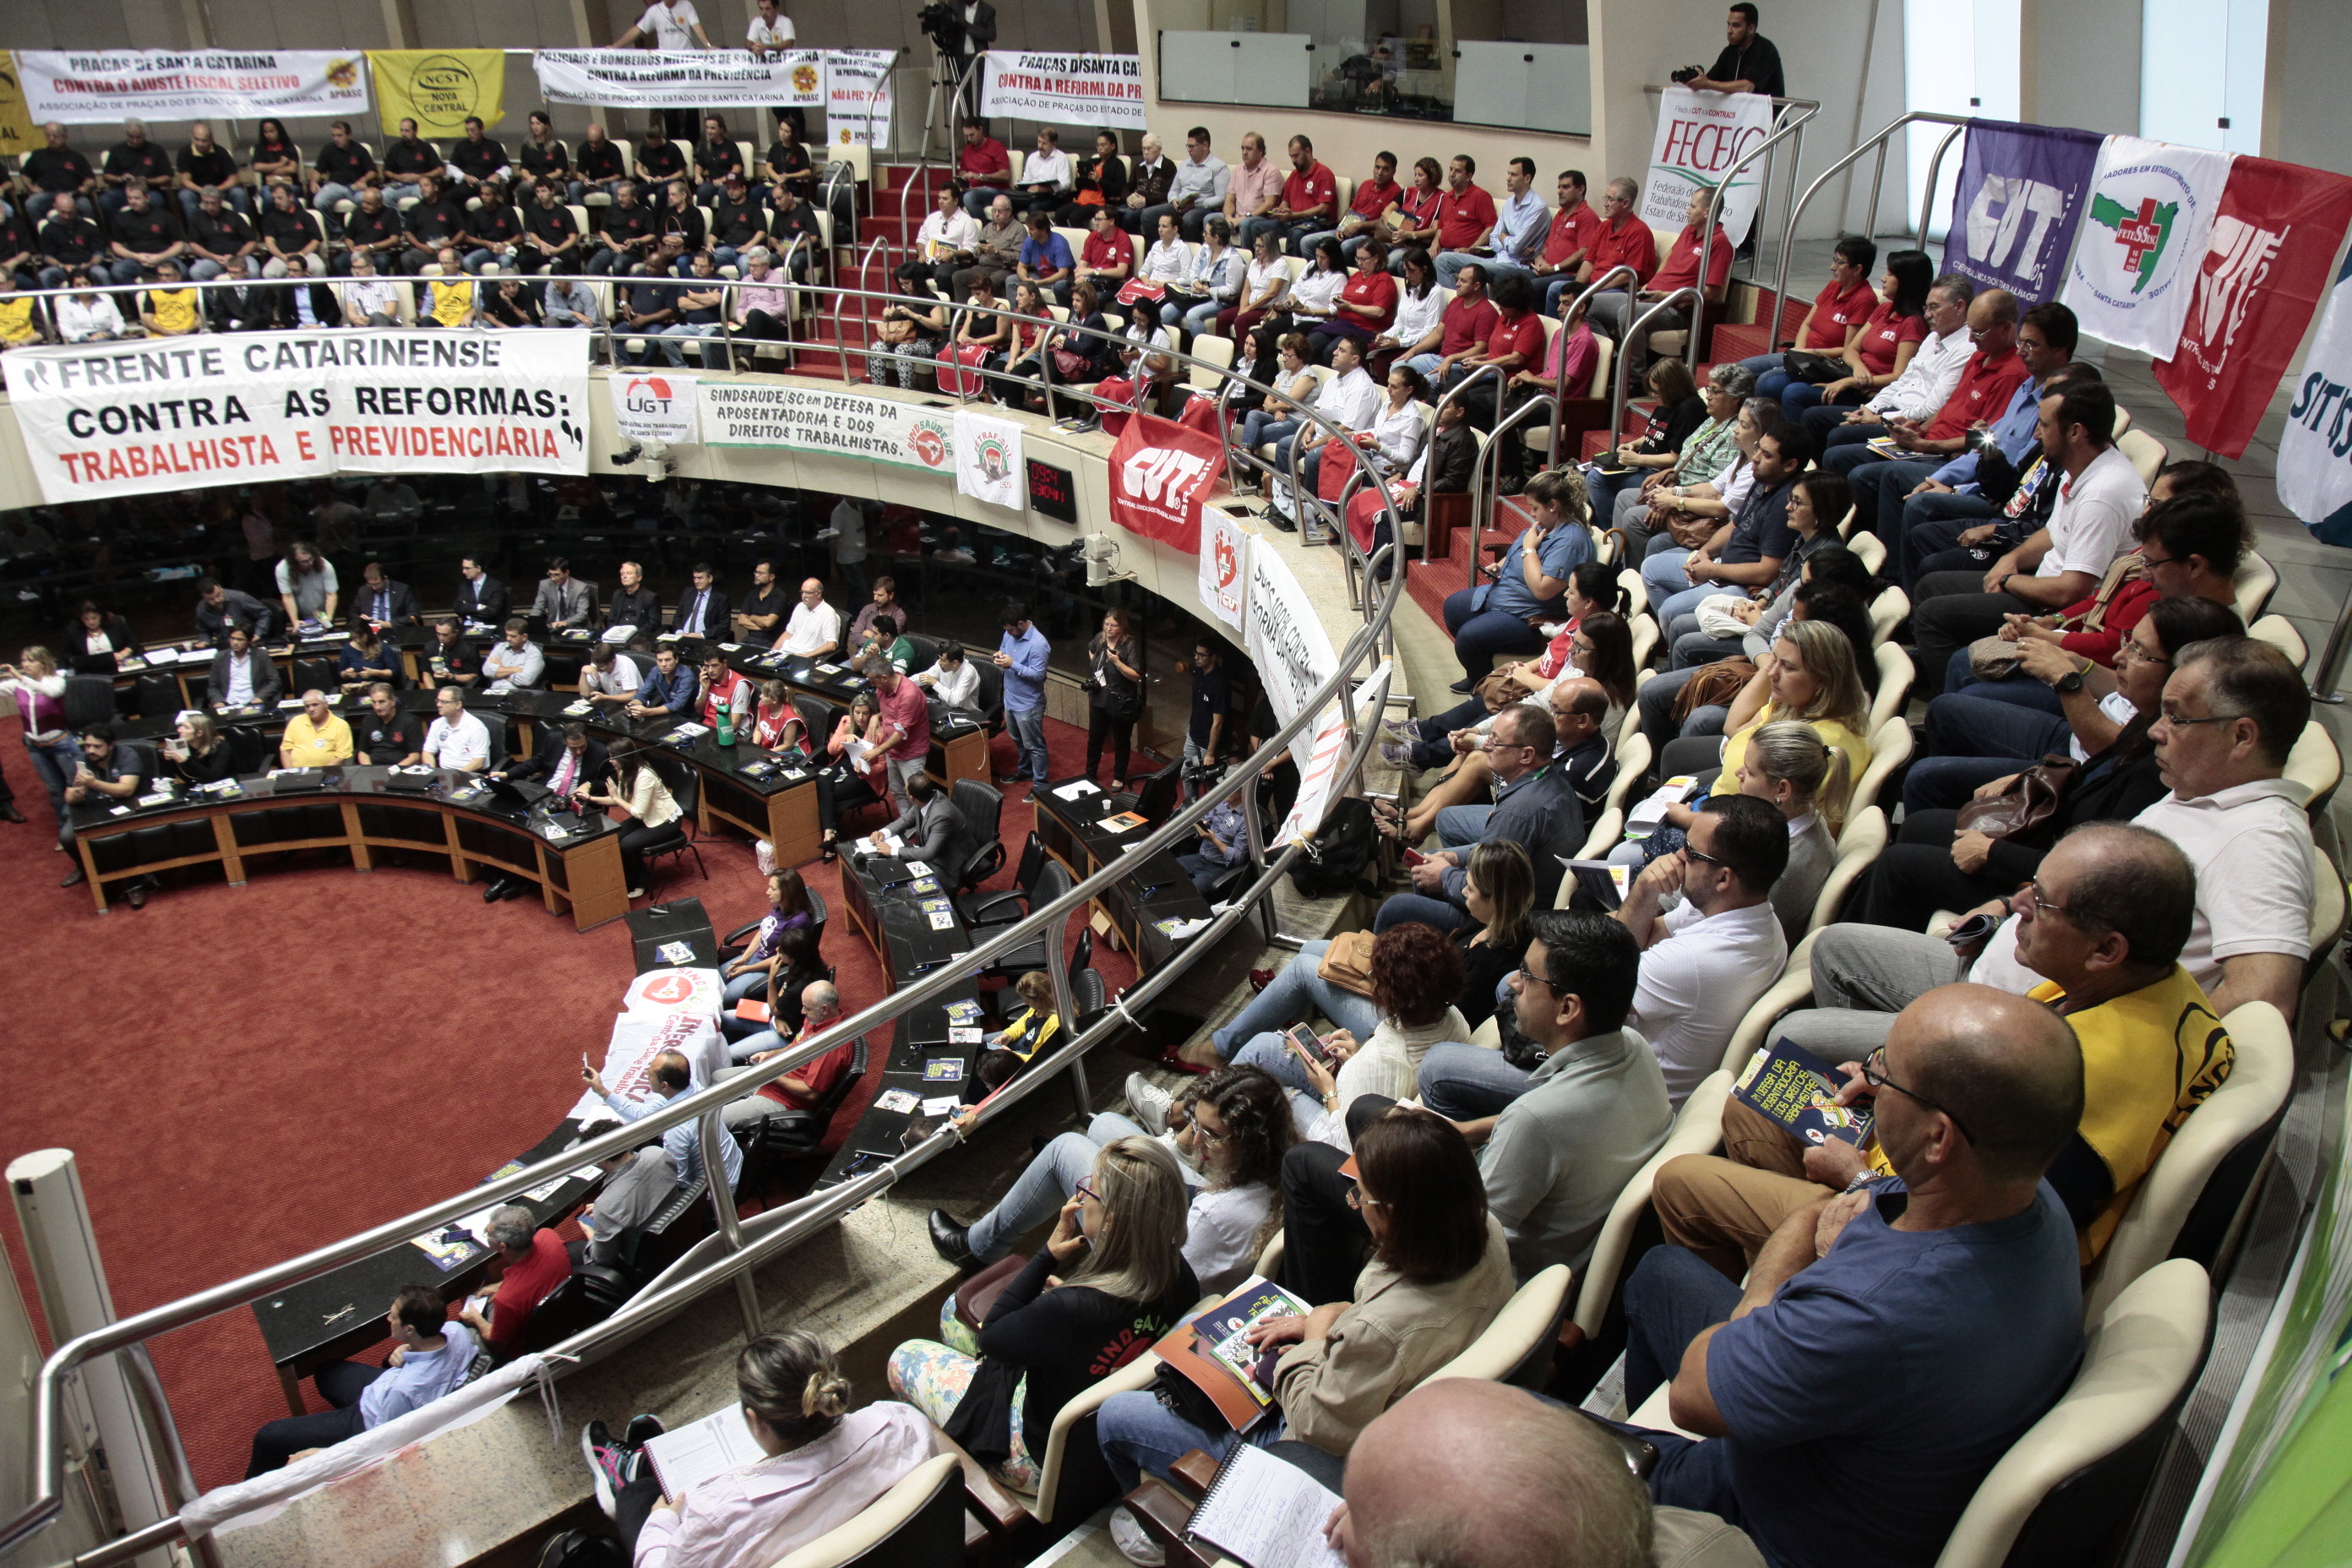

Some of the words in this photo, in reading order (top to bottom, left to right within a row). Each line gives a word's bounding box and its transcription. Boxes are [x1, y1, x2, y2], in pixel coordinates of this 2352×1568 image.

[206, 55, 277, 70] CATARINA
[601, 53, 661, 65] BOMBEIROS
[1019, 55, 1067, 73] PRAÇAS
[1083, 58, 1119, 75] SANTA
[427, 74, 460, 84] NCST
[587, 69, 628, 81] CONTRA
[689, 69, 702, 80] DA
[705, 68, 771, 80] PREVIDÊNCIA
[53, 79, 115, 94] CONTRA
[132, 75, 182, 91] AJUSTE
[186, 75, 234, 90] FISCAL
[239, 74, 301, 90] SELETIVO
[999, 74, 1041, 91] CONTRA
[1044, 78, 1053, 91] A
[1056, 79, 1105, 96] REFORMA
[1108, 82, 1124, 97] DA
[432, 92, 458, 101] NOVA
[598, 92, 610, 101] DE
[649, 94, 660, 102] DO
[663, 94, 695, 102] ESTADO
[699, 94, 709, 102] DE
[712, 93, 739, 102] SANTA
[742, 93, 784, 101] CATARINA
[792, 93, 819, 102] APRASC
[852, 90, 864, 101] PEC
[39, 100, 107, 112] ASSOCIAÇÃO
[110, 100, 122, 110] DE
[128, 98, 166, 110] PRAÇAS
[424, 103, 469, 113] CENTRAL
[1039, 101, 1050, 109] DE
[1053, 101, 1083, 112] PRAÇAS
[1086, 105, 1098, 113] DO
[1101, 106, 1129, 116] ESTADO
[1132, 107, 1141, 117] DE
[1709, 108, 1736, 119] CONTRACS
[854, 131, 876, 141] APRAC
[1662, 119, 1767, 174] FECESC
[1652, 180, 1685, 198] Federação
[2139, 165, 2151, 173] EM
[2186, 195, 2197, 210] DE
[1650, 193, 1690, 210] Trabalhadore
[1645, 205, 1665, 219] Estado
[1666, 209, 1676, 221] de
[2093, 289, 2111, 305] SANTA
[244, 338, 502, 373] CATARINENSE
[67, 395, 251, 438] CONTRA
[285, 388, 330, 418] AS
[354, 386, 569, 418] REFORMAS:
[626, 397, 672, 415] UGT
[710, 388, 804, 406] SINDSAÚDE/SC
[806, 395, 822, 406] em
[825, 395, 874, 416] DEFESA
[879, 404, 898, 421] DA
[716, 406, 828, 427] APOSENTADORIA
[834, 416, 841, 428] E
[847, 417, 875, 434] DOS
[729, 424, 790, 439] DIREITOS
[796, 427, 904, 457] TRABALHISTAS.
[58, 433, 280, 484] TRABALHISTA
[295, 430, 317, 461] E
[1123, 447, 1206, 509] CUT
[1180, 456, 1216, 517] BRASIL
[1271, 596, 1293, 636] 100%
[1760, 1072, 1778, 1097] DEFESA
[1772, 1059, 1787, 1073] DA
[1783, 1070, 1810, 1104] DIREITOS
